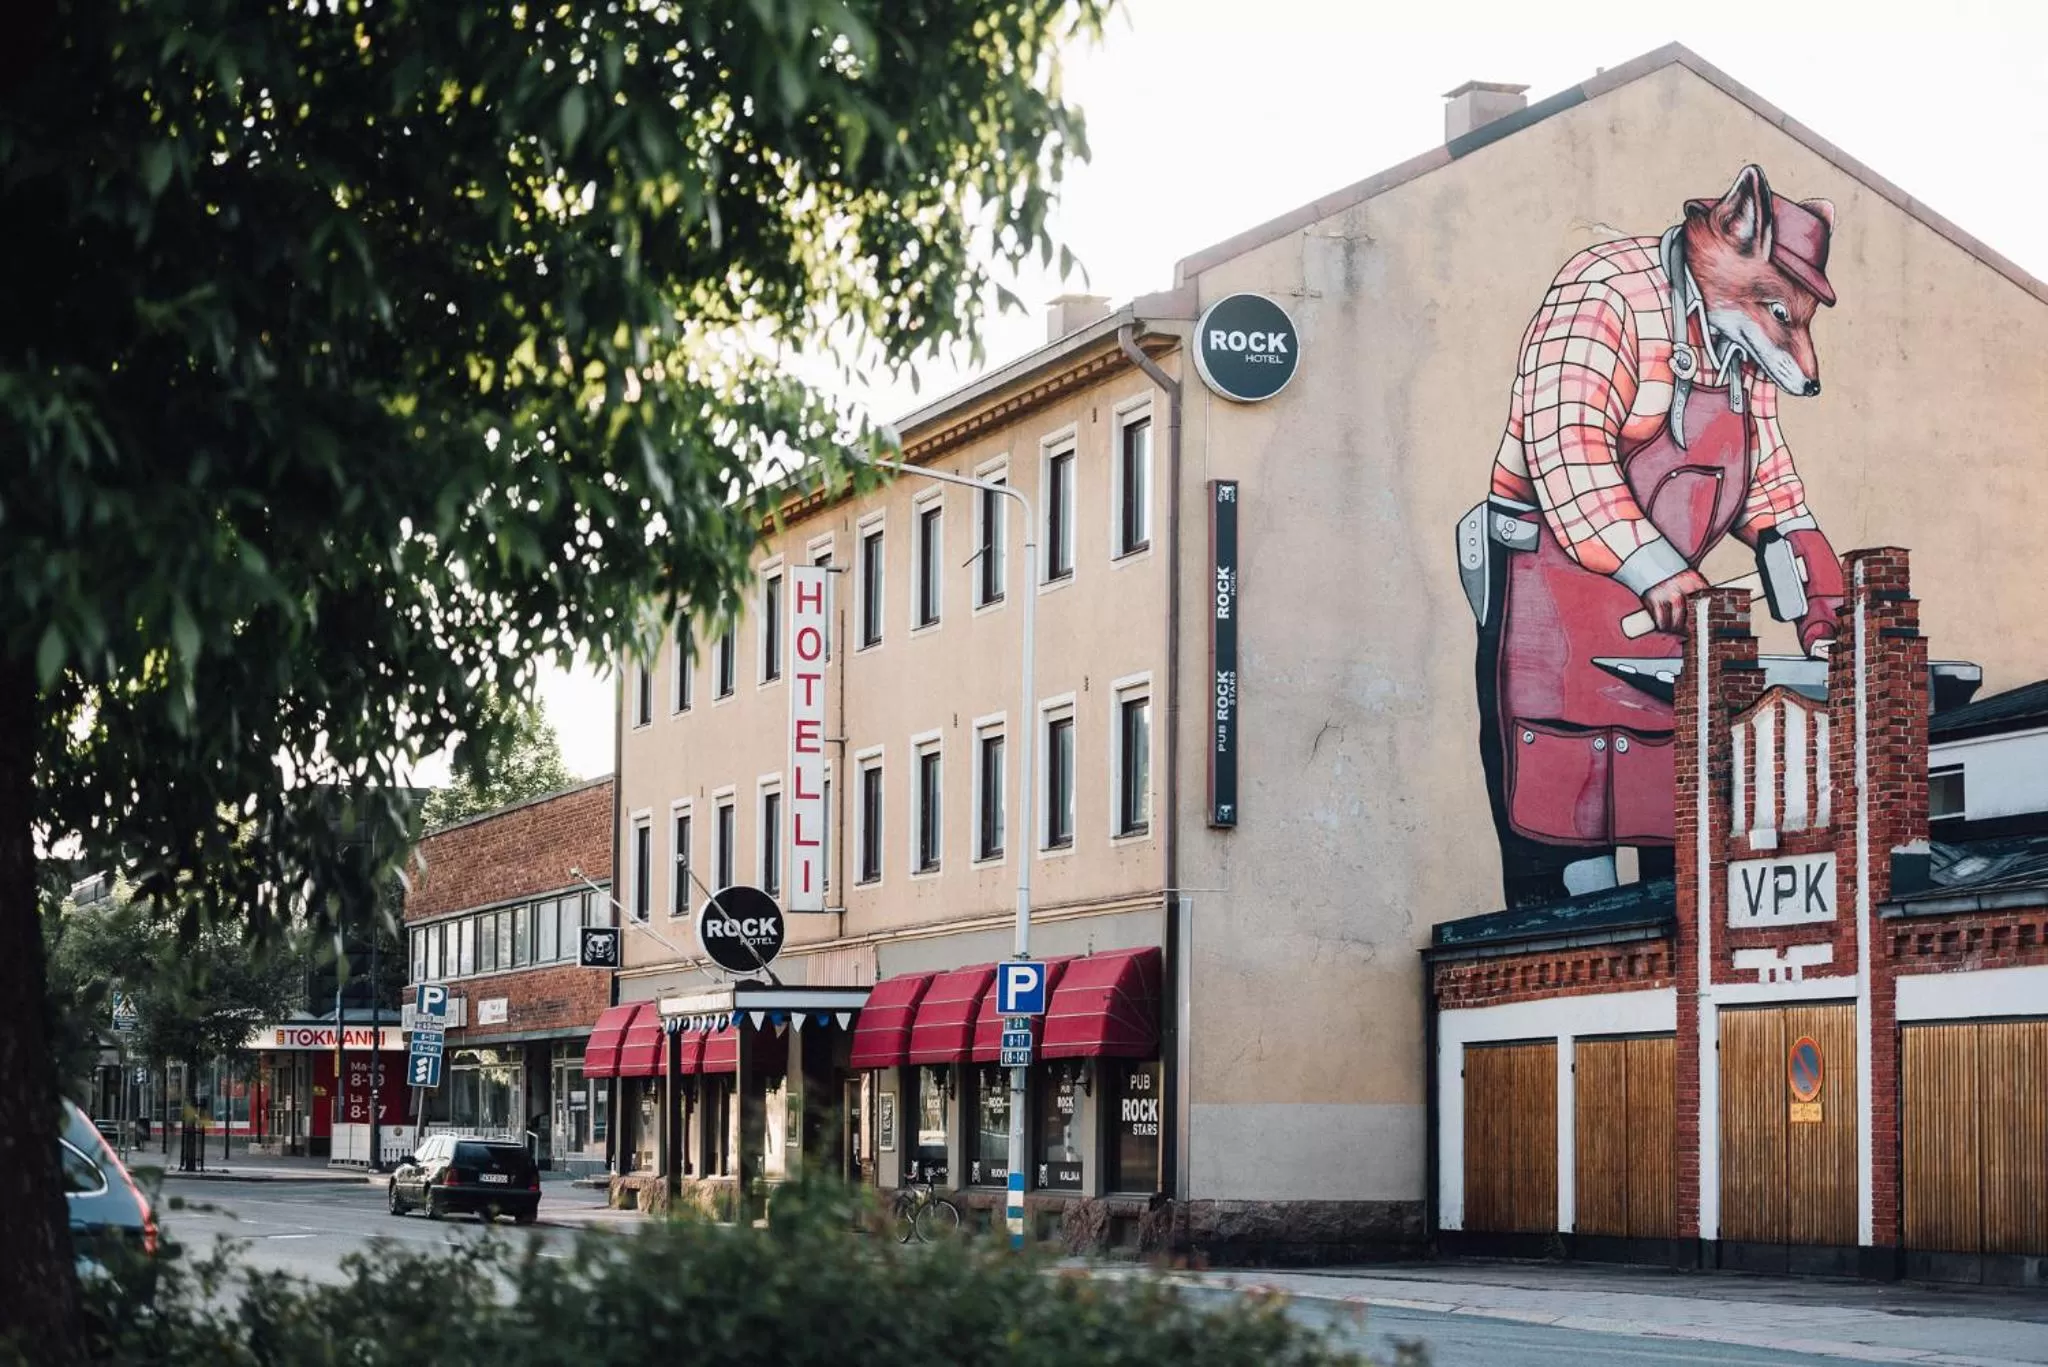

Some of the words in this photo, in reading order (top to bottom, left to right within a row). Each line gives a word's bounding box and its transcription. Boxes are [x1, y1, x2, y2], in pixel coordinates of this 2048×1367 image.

[1209, 330, 1288, 353] ROCK
[1245, 354, 1284, 365] HOTEL
[1217, 565, 1230, 620] ROCK
[1217, 670, 1229, 721] ROCK
[795, 580, 822, 893] HOTELLI
[1218, 724, 1227, 752] PUB
[1741, 861, 1828, 917] VPK
[706, 917, 778, 938] ROCK
[1007, 966, 1038, 1010] P
[422, 987, 444, 1013] P
[1008, 1034, 1025, 1047] 8-17
[1130, 1074, 1151, 1090] PUB
[351, 1093, 363, 1103] La
[988, 1097, 1005, 1108] ROCK
[1057, 1095, 1074, 1108] ROCK
[351, 1105, 387, 1120] 8-7
[1122, 1098, 1158, 1122] ROCK
[1133, 1123, 1158, 1136] STARS
